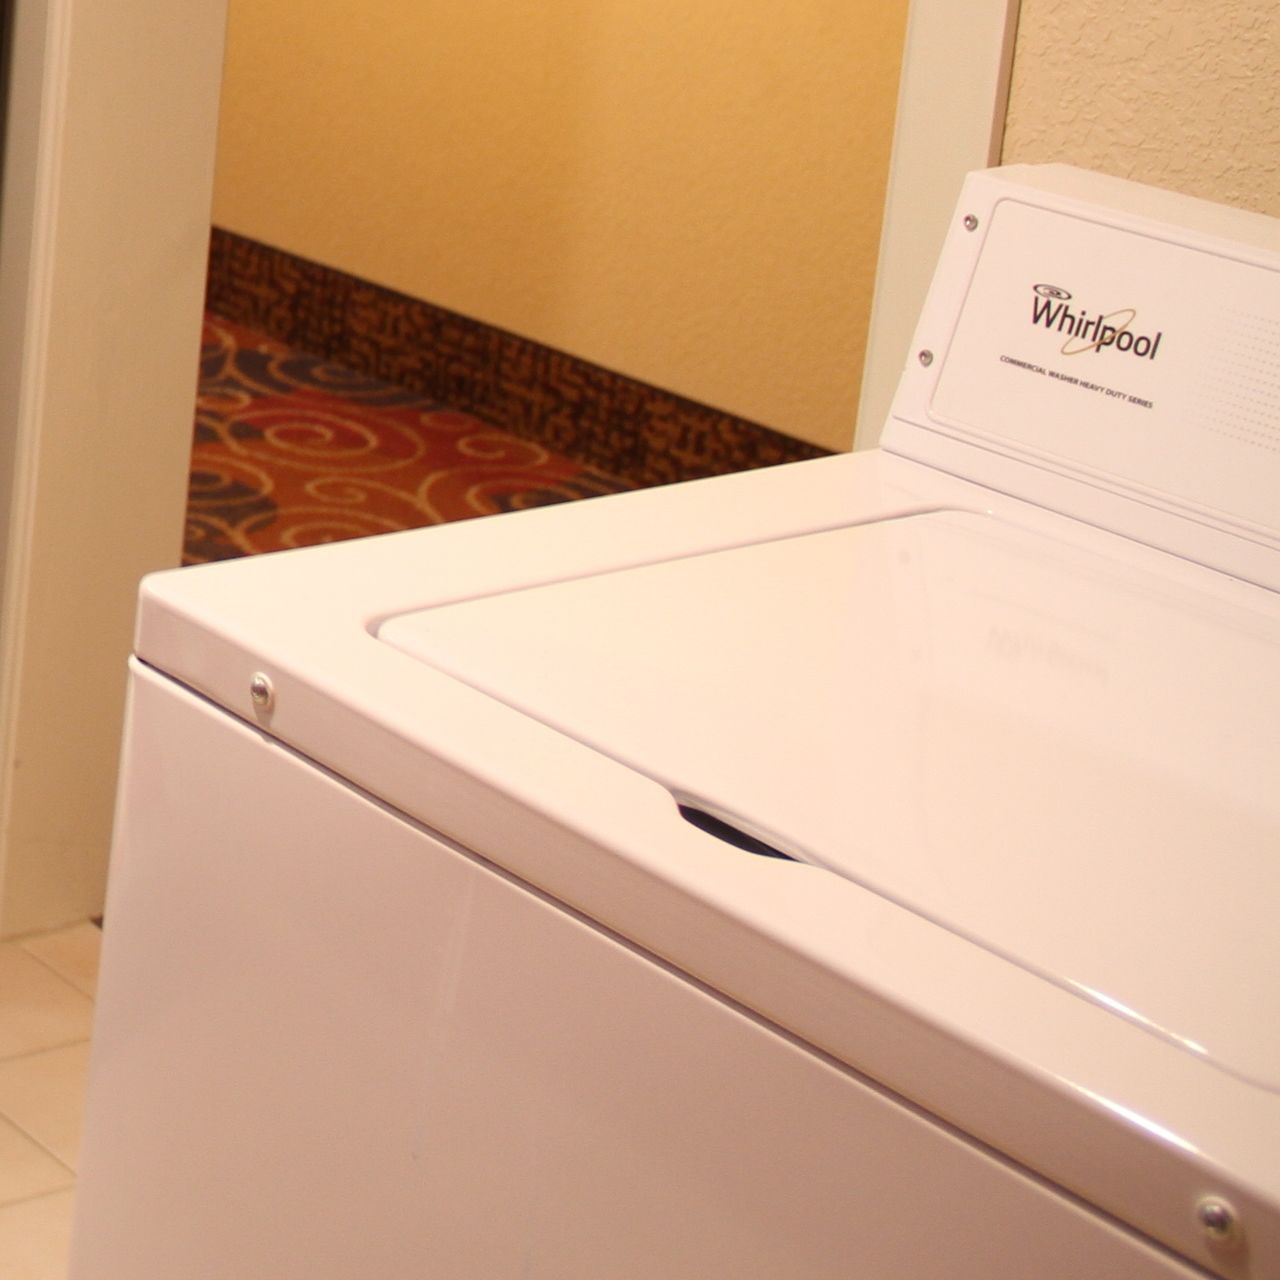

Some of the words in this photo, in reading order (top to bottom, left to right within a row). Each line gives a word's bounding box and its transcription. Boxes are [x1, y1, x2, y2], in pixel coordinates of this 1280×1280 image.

[1031, 295, 1163, 361] Whirlpool
[999, 354, 1048, 377] COMMERCIAL
[1048, 369, 1080, 387] WASHER
[1080, 379, 1106, 394] HEAVY
[1105, 387, 1128, 402] DUTY
[1127, 394, 1154, 410] SERIES
